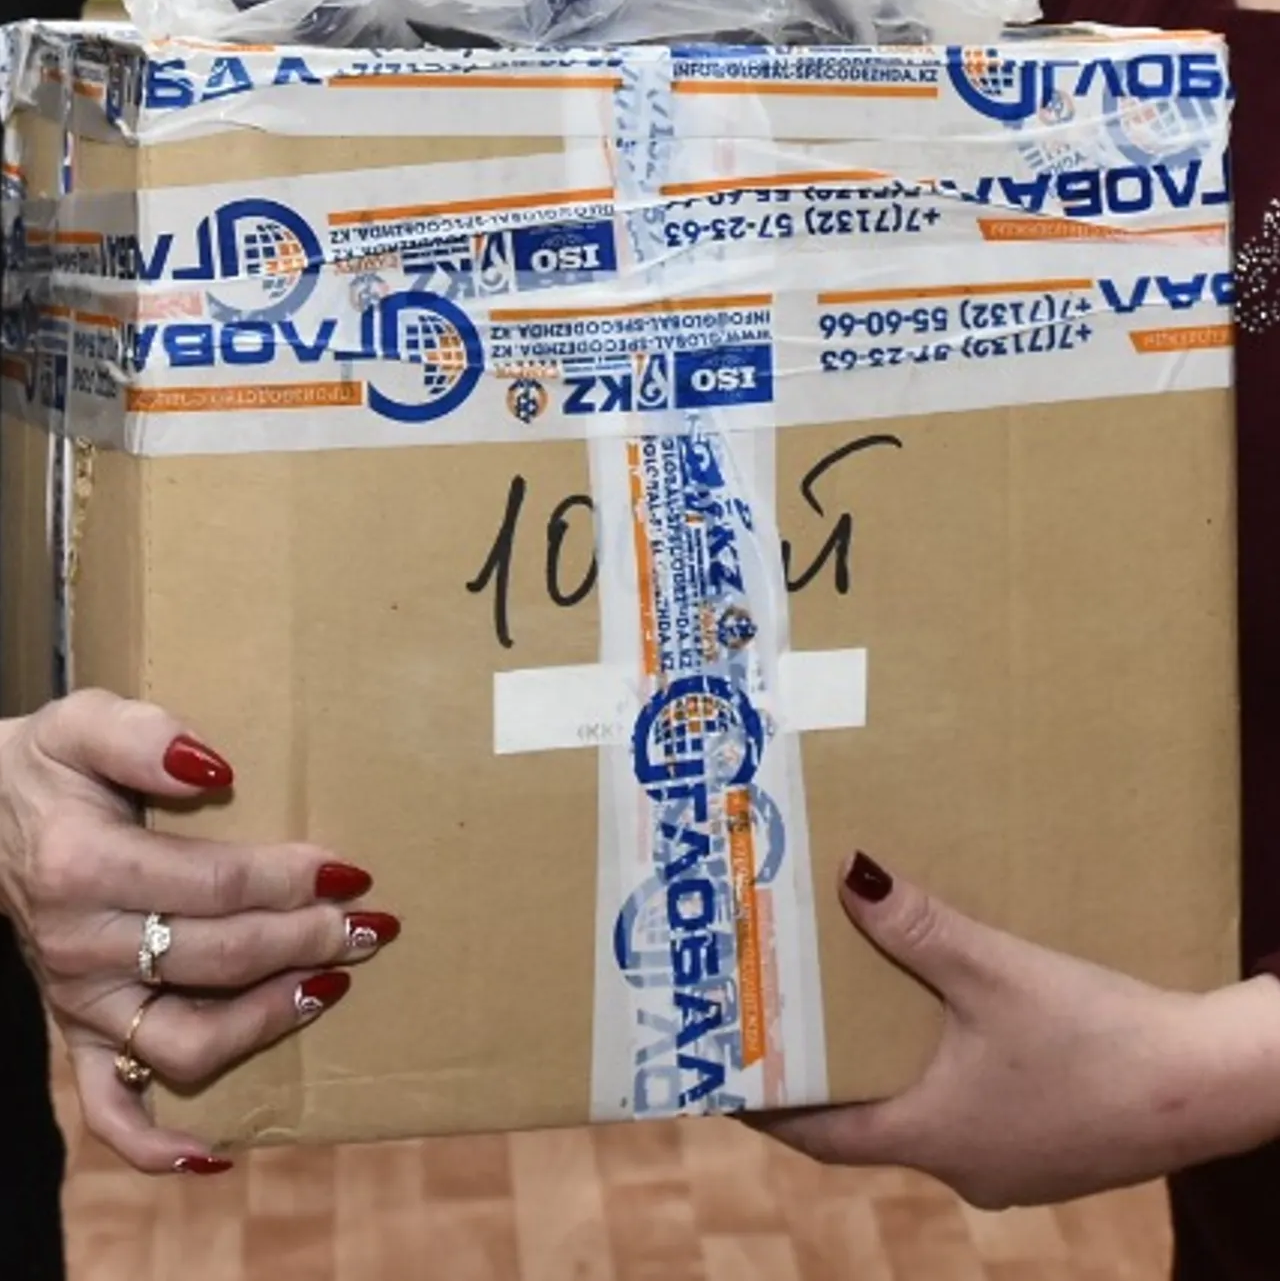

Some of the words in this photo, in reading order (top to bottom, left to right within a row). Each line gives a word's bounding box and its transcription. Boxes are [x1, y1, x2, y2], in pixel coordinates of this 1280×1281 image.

[531, 244, 601, 272] ISO
[820, 306, 948, 339] 55-60-66
[562, 373, 633, 415] KZ
[690, 365, 756, 392] ISO
[646, 783, 726, 1107] ГЛОБАЛ
